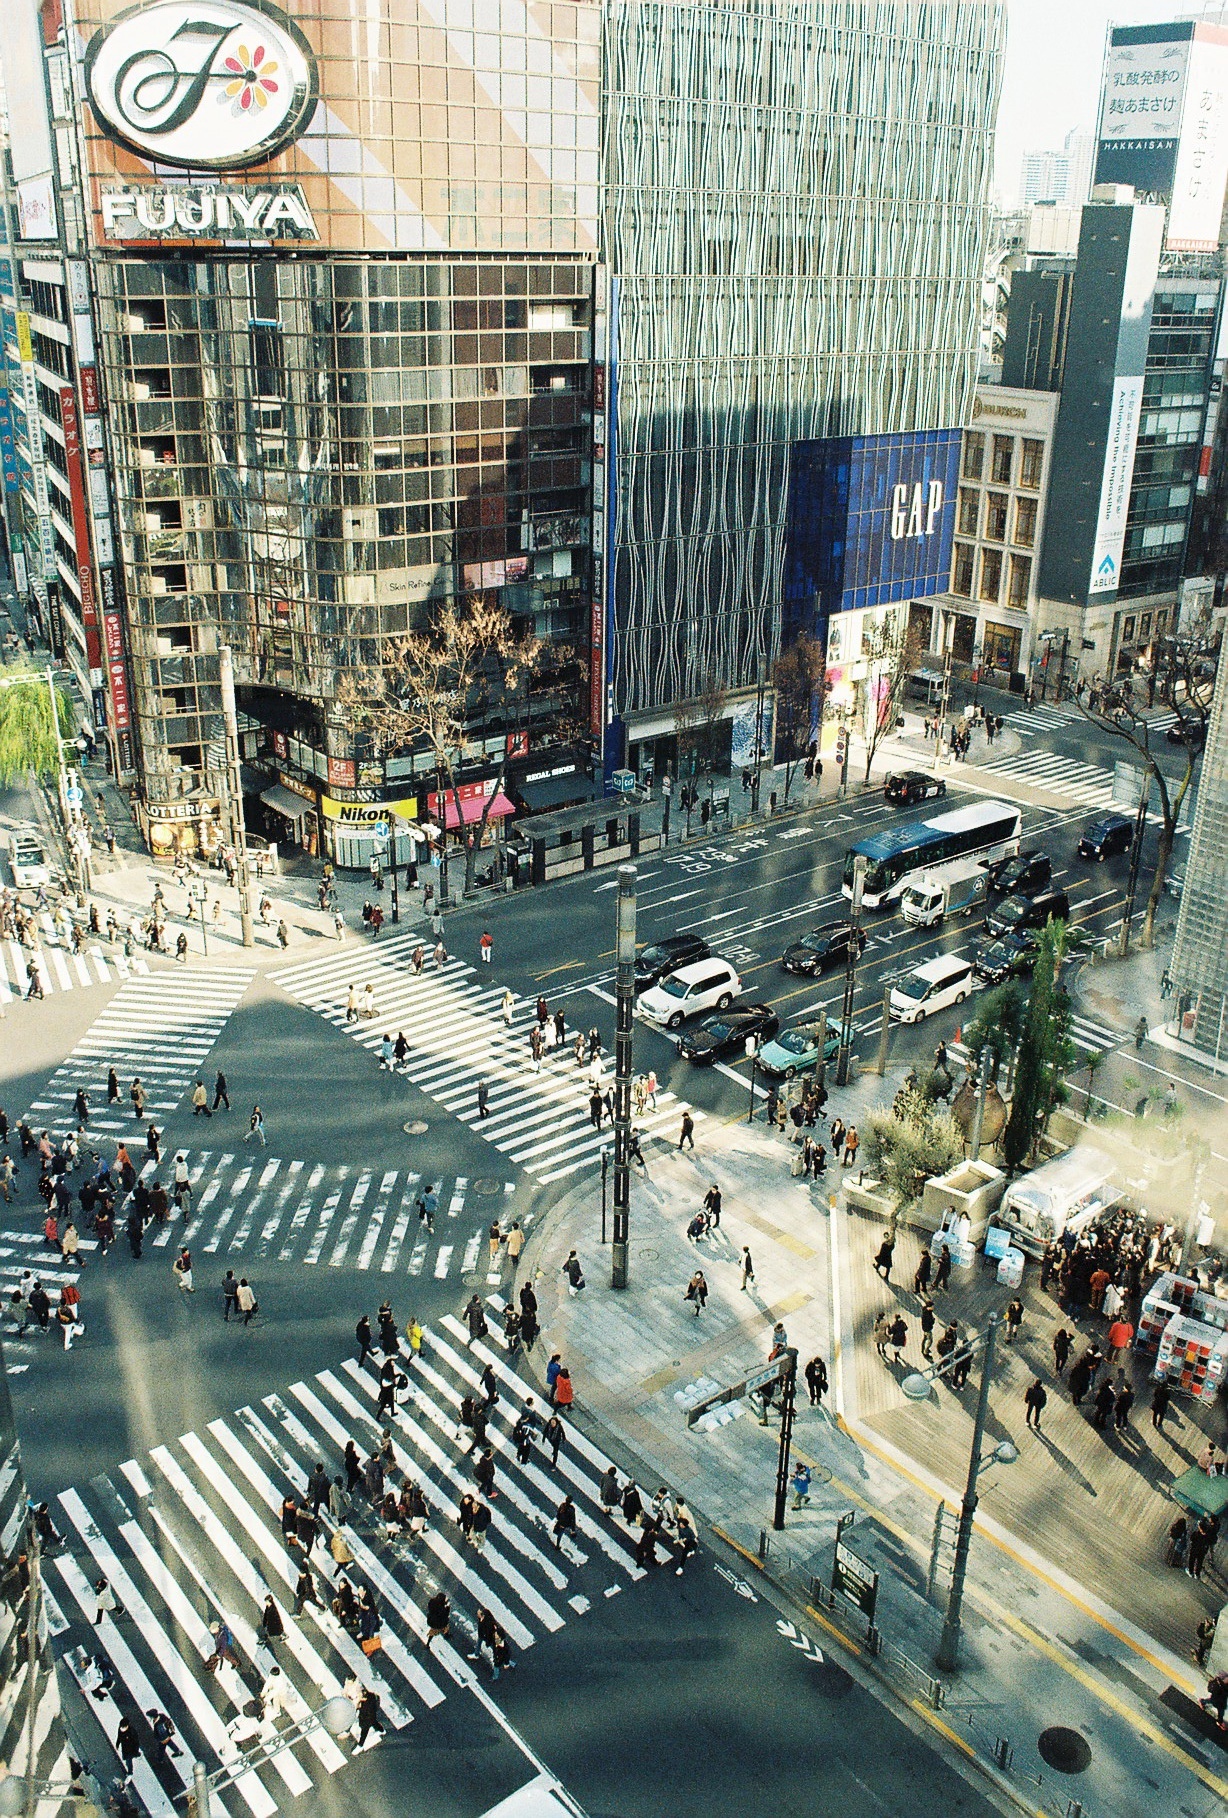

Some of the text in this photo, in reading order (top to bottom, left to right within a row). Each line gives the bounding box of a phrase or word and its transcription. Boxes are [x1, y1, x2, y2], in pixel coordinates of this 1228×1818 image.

[1112, 69, 1180, 87] 乳酸発酵の
[1103, 140, 1174, 151] HAKKAISAN
[101, 192, 314, 231] FUJIYA
[983, 404, 1028, 420] BURCH
[1112, 391, 1126, 444] Achieving
[62, 396, 79, 457] カラオケ
[1105, 466, 1118, 521] Impossible
[891, 480, 943, 540] GAP
[389, 581, 406, 592] Skin
[407, 577, 431, 589] Refine
[1093, 576, 1116, 588] ABLIC
[113, 676, 126, 714] 不二家
[123, 740, 132, 769] LOTTERIA
[332, 760, 347, 772] 2F
[526, 764, 576, 783] REGAL SHOES
[146, 802, 212, 817] LOTTERIA
[339, 806, 390, 822] Nikon
[663, 854, 712, 873] 17-19
[717, 944, 761, 965] 8-20
